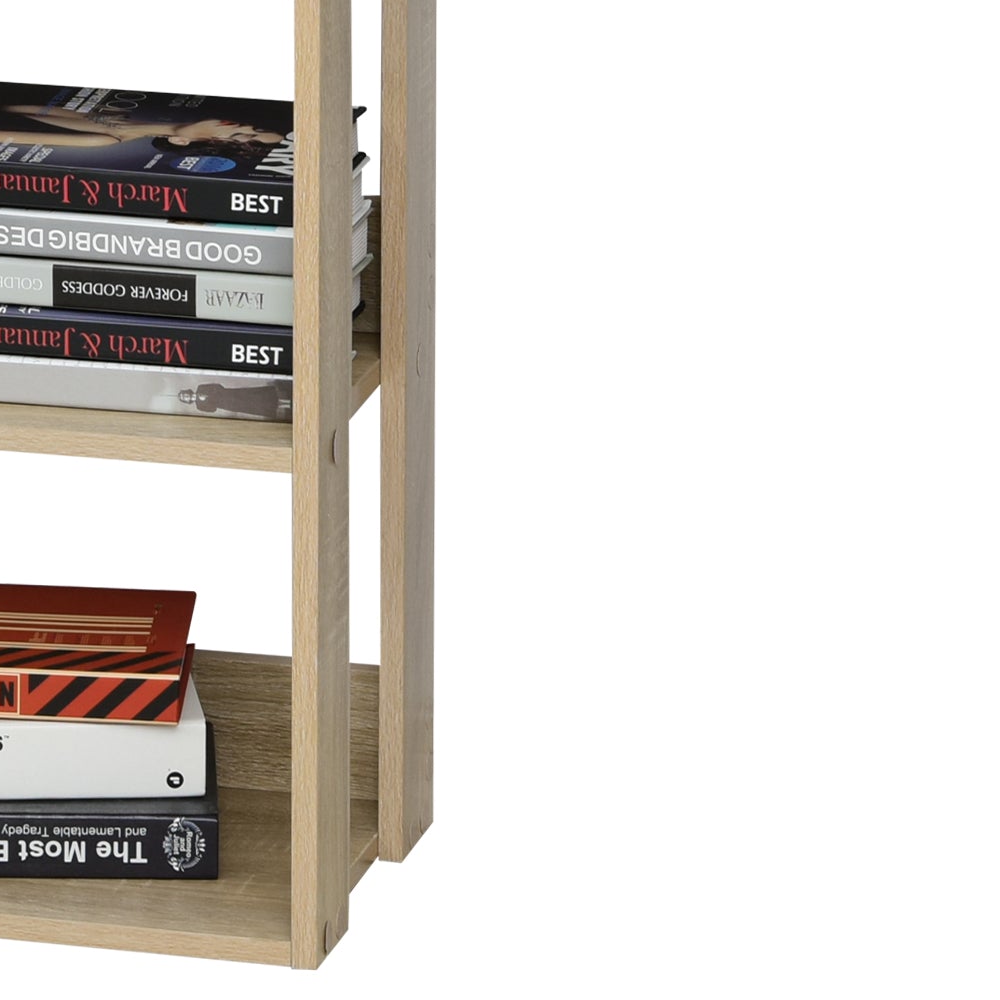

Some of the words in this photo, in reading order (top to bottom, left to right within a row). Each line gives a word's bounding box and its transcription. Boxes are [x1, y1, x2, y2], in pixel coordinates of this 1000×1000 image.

[80, 179, 100, 207] &
[108, 181, 188, 213] March
[231, 192, 283, 214] BEST
[186, 241, 262, 265] GOOD
[61, 280, 126, 297] GODDESS
[130, 285, 188, 302] FOREVER
[81, 332, 101, 358] &
[109, 334, 189, 364] March
[231, 343, 284, 366] BEST
[1, 824, 49, 837] Tragedy
[53, 826, 121, 837] Lamentable
[125, 826, 147, 837] and
[18, 838, 86, 863] Most
[95, 839, 148, 864] The
